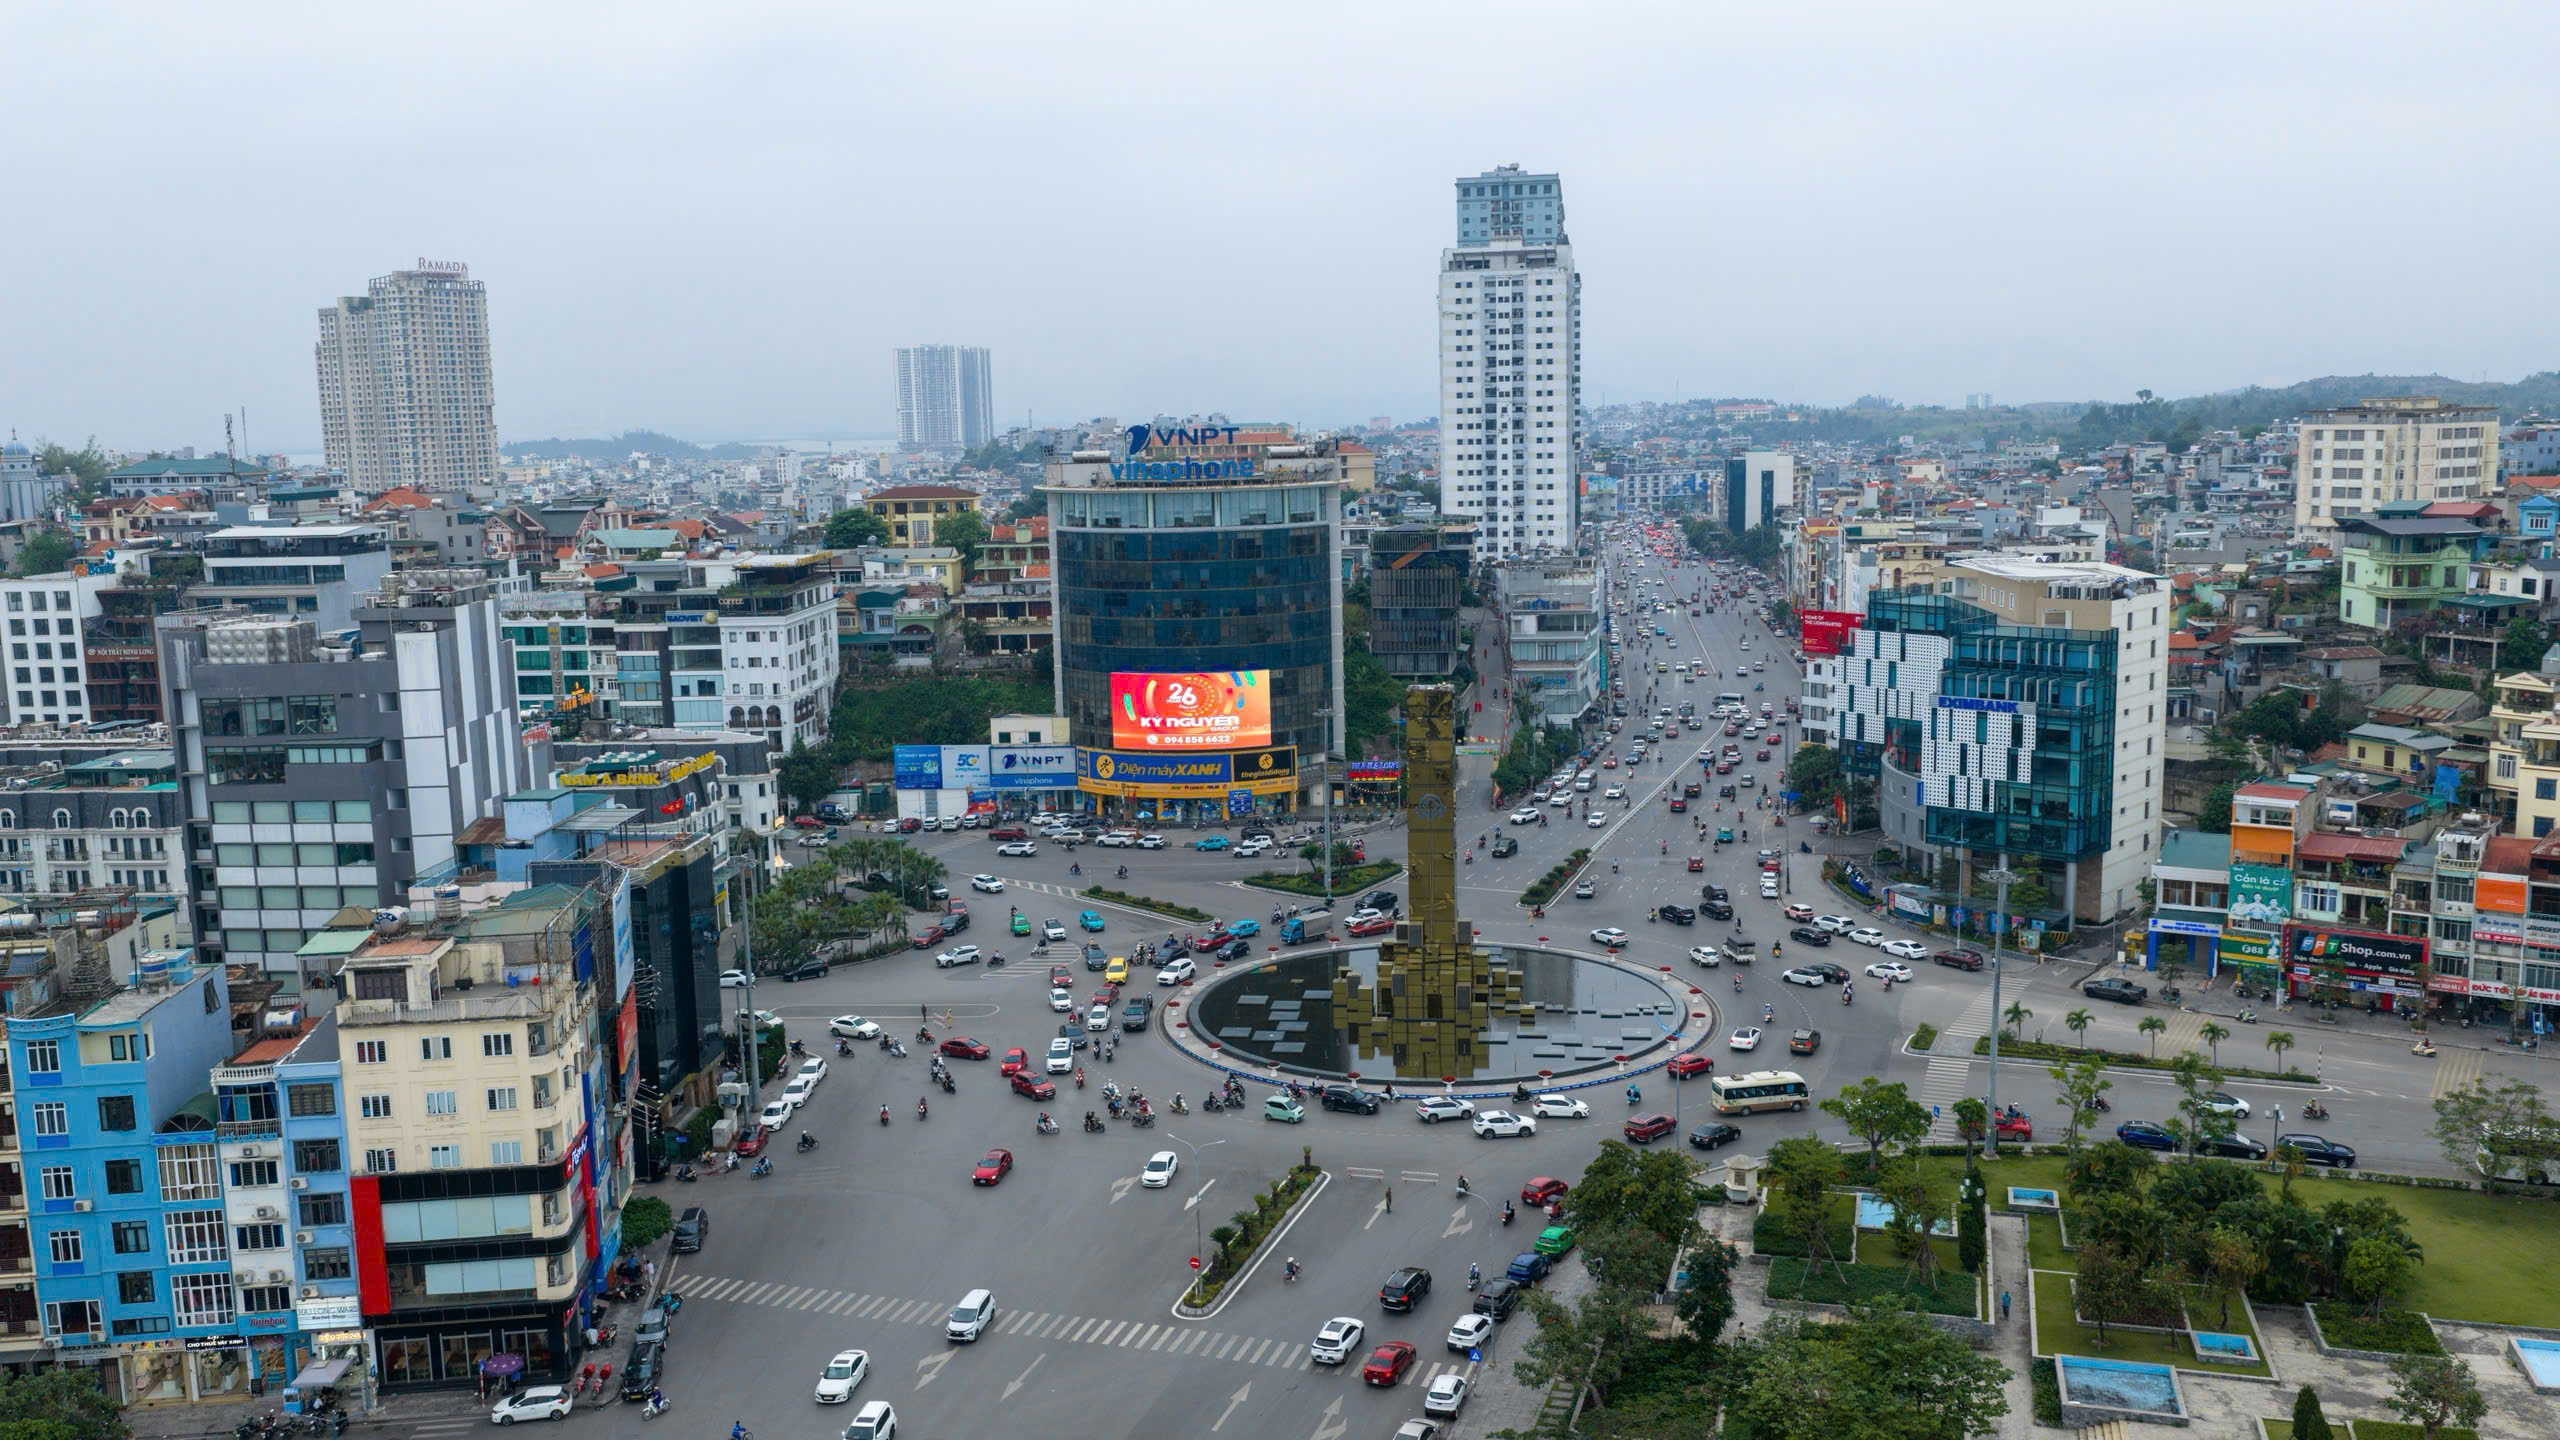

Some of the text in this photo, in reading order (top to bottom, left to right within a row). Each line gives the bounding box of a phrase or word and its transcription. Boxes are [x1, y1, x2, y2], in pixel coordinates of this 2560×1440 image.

[418, 257, 468, 272] RAMADA
[1155, 427, 1239, 446] VNPT
[1110, 456, 1255, 483] vinaphone
[122, 648, 138, 656] MINH
[139, 648, 154, 656] LONG
[1168, 683, 1197, 705] 26
[1938, 696, 2019, 714] EXIMBANK
[1164, 735, 1231, 744] 094 858 6622
[957, 754, 977, 767] 5G
[1021, 756, 1064, 765] VNPT
[1117, 762, 1146, 776] Điện
[1241, 768, 1290, 779] thegioididong
[559, 773, 598, 786] NAM
[615, 772, 660, 785] BANK
[1014, 777, 1054, 785] vinaphone
[2259, 876, 2271, 885] là
[2340, 942, 2411, 960] Shop.com.vn
[2364, 963, 2382, 972] Apple
[2471, 984, 2492, 993] ĐỨC
[2539, 992, 2554, 1000] QUY
